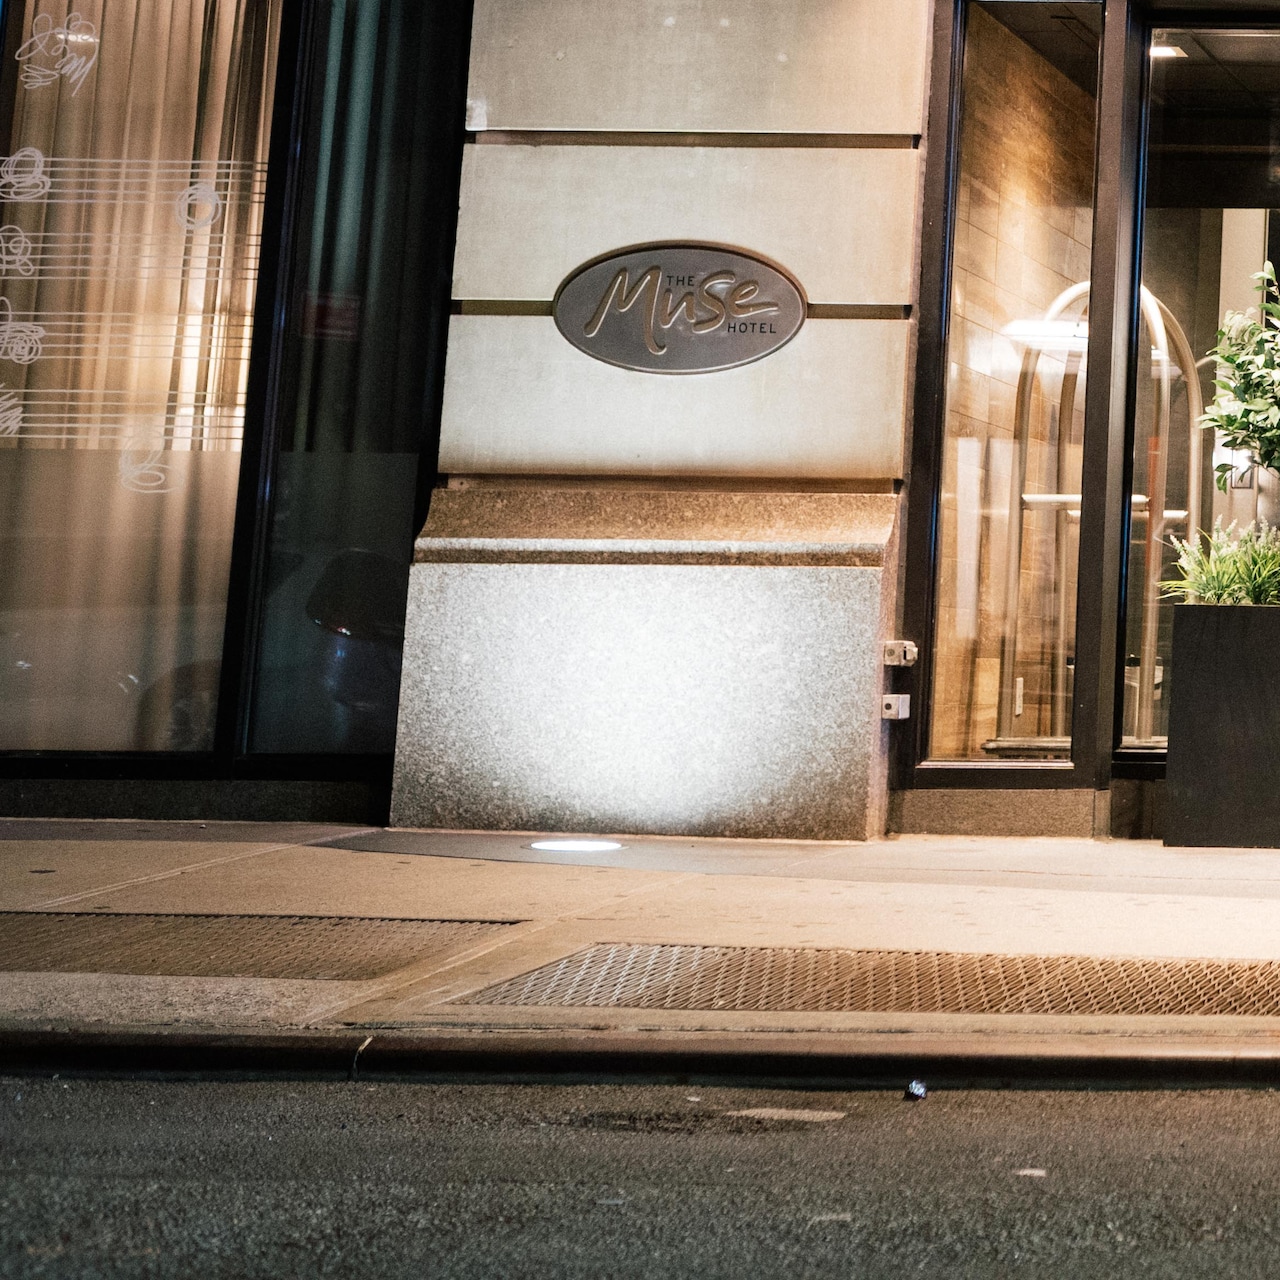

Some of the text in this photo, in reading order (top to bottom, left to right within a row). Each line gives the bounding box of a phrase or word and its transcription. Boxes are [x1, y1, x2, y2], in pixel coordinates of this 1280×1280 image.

[666, 275, 695, 286] THE
[583, 265, 778, 355] Muse
[727, 322, 777, 334] HOTEL
